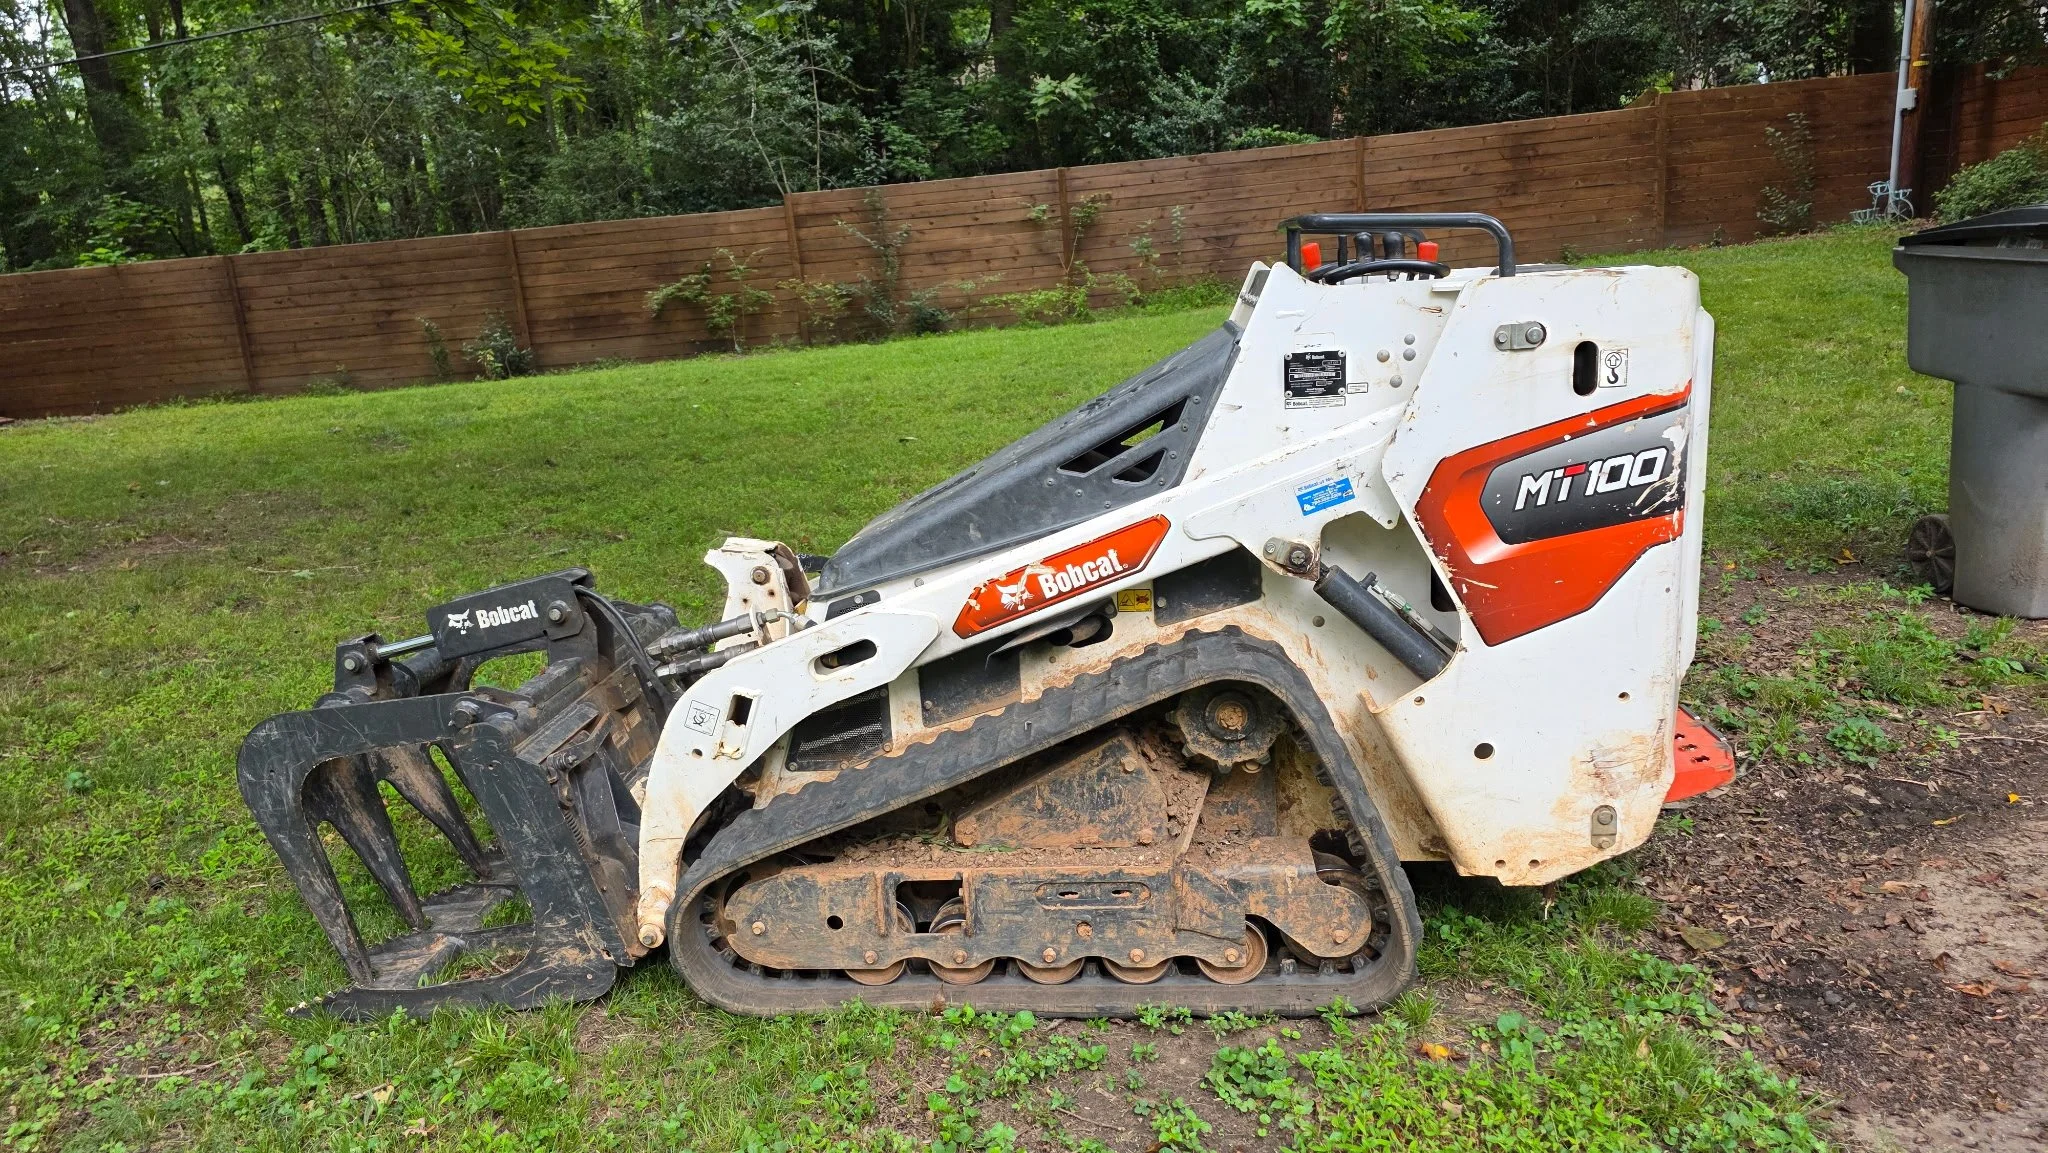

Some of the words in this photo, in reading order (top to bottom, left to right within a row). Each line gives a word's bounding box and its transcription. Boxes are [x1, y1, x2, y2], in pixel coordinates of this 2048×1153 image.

[1514, 447, 1668, 511] MT100
[1037, 548, 1124, 600] Bobcat
[475, 599, 539, 629] Bobcat
